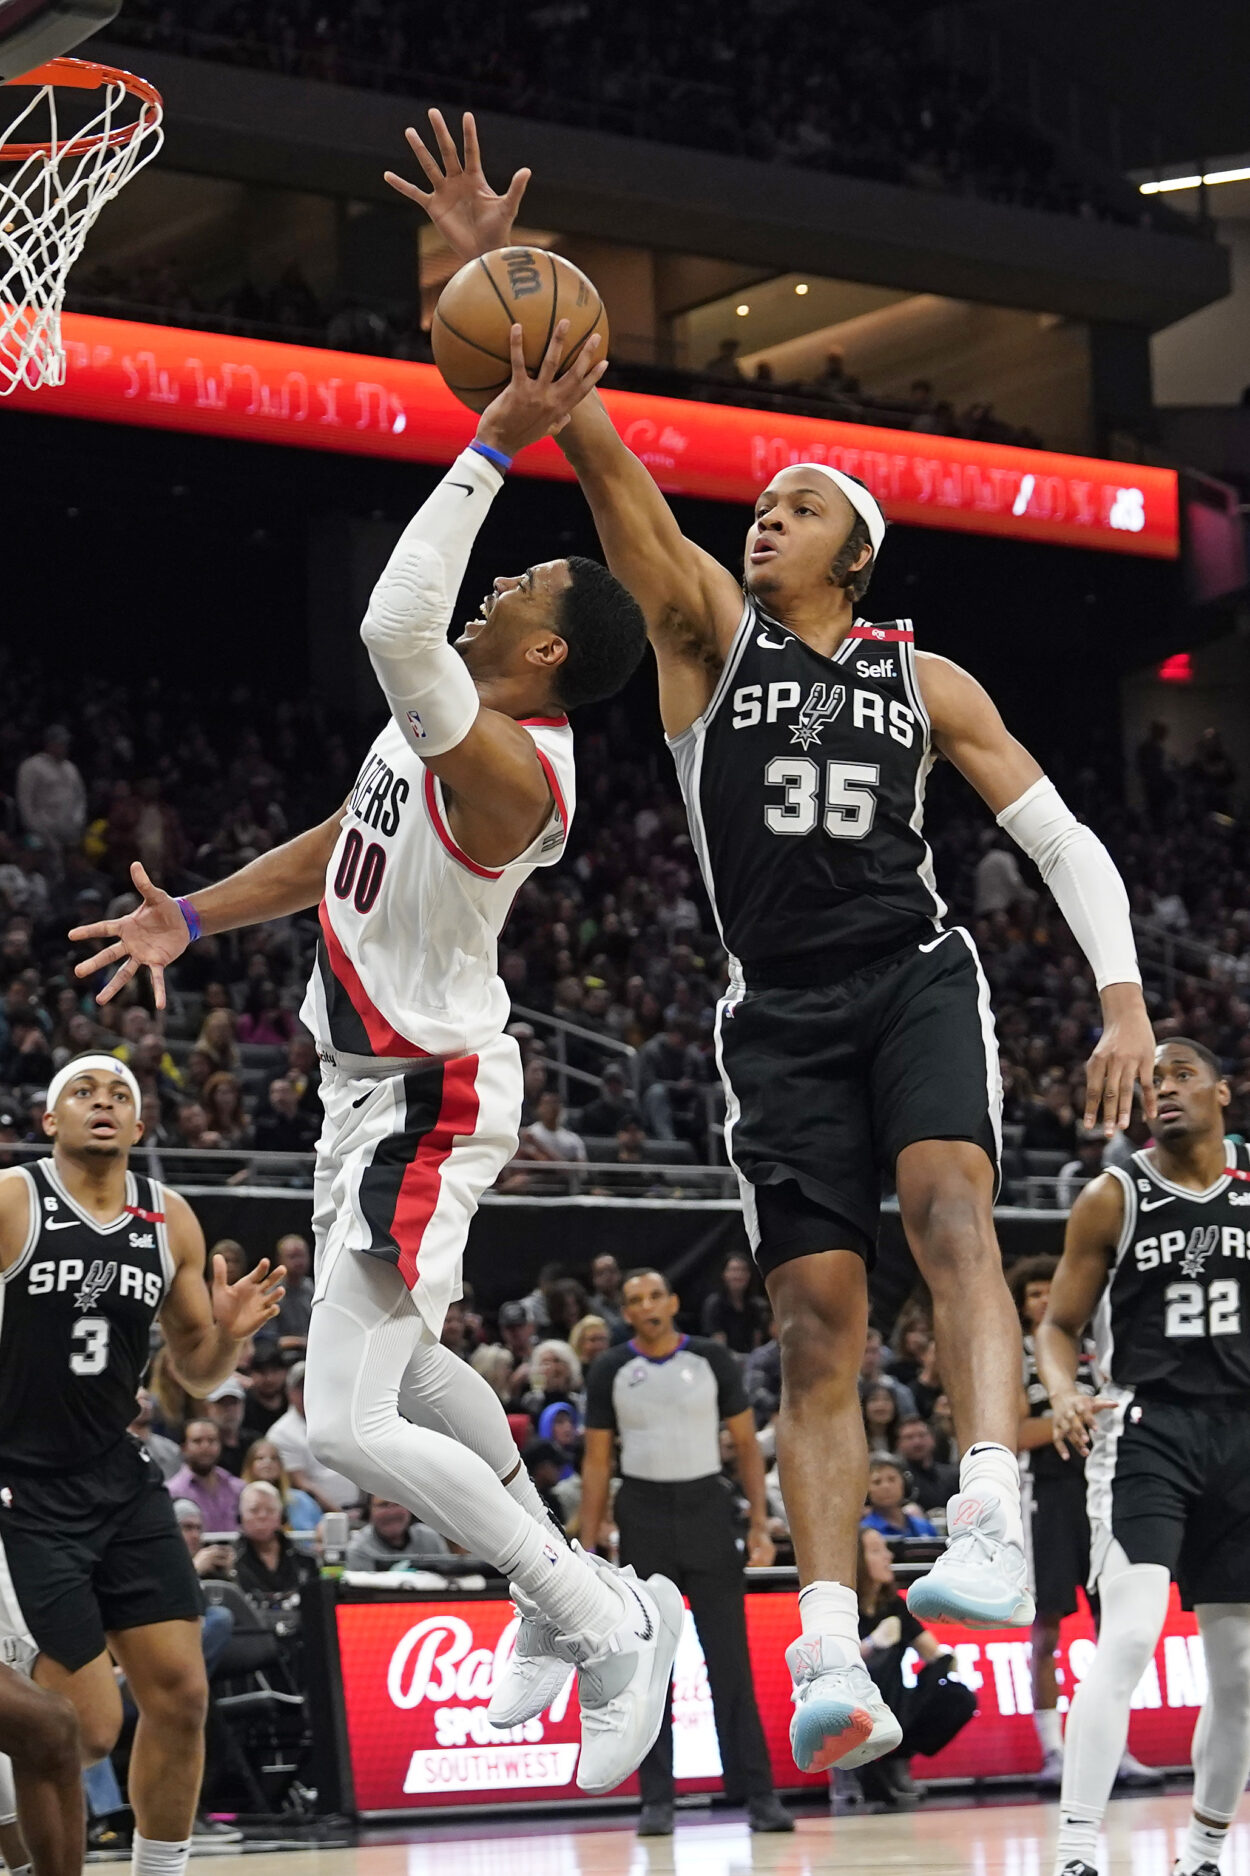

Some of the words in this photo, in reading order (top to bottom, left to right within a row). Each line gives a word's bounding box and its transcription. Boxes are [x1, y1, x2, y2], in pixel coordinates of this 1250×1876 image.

[731, 680, 916, 751] SPURS
[764, 755, 881, 840] 35
[333, 827, 387, 915] 00
[43, 1196, 59, 1212] 6
[1134, 1224, 1250, 1280] SPUR
[27, 1258, 163, 1313] SPURS
[1164, 1277, 1242, 1338] 22
[69, 1315, 111, 1376] 3
[423, 1751, 562, 1784] SOUTHWEST
